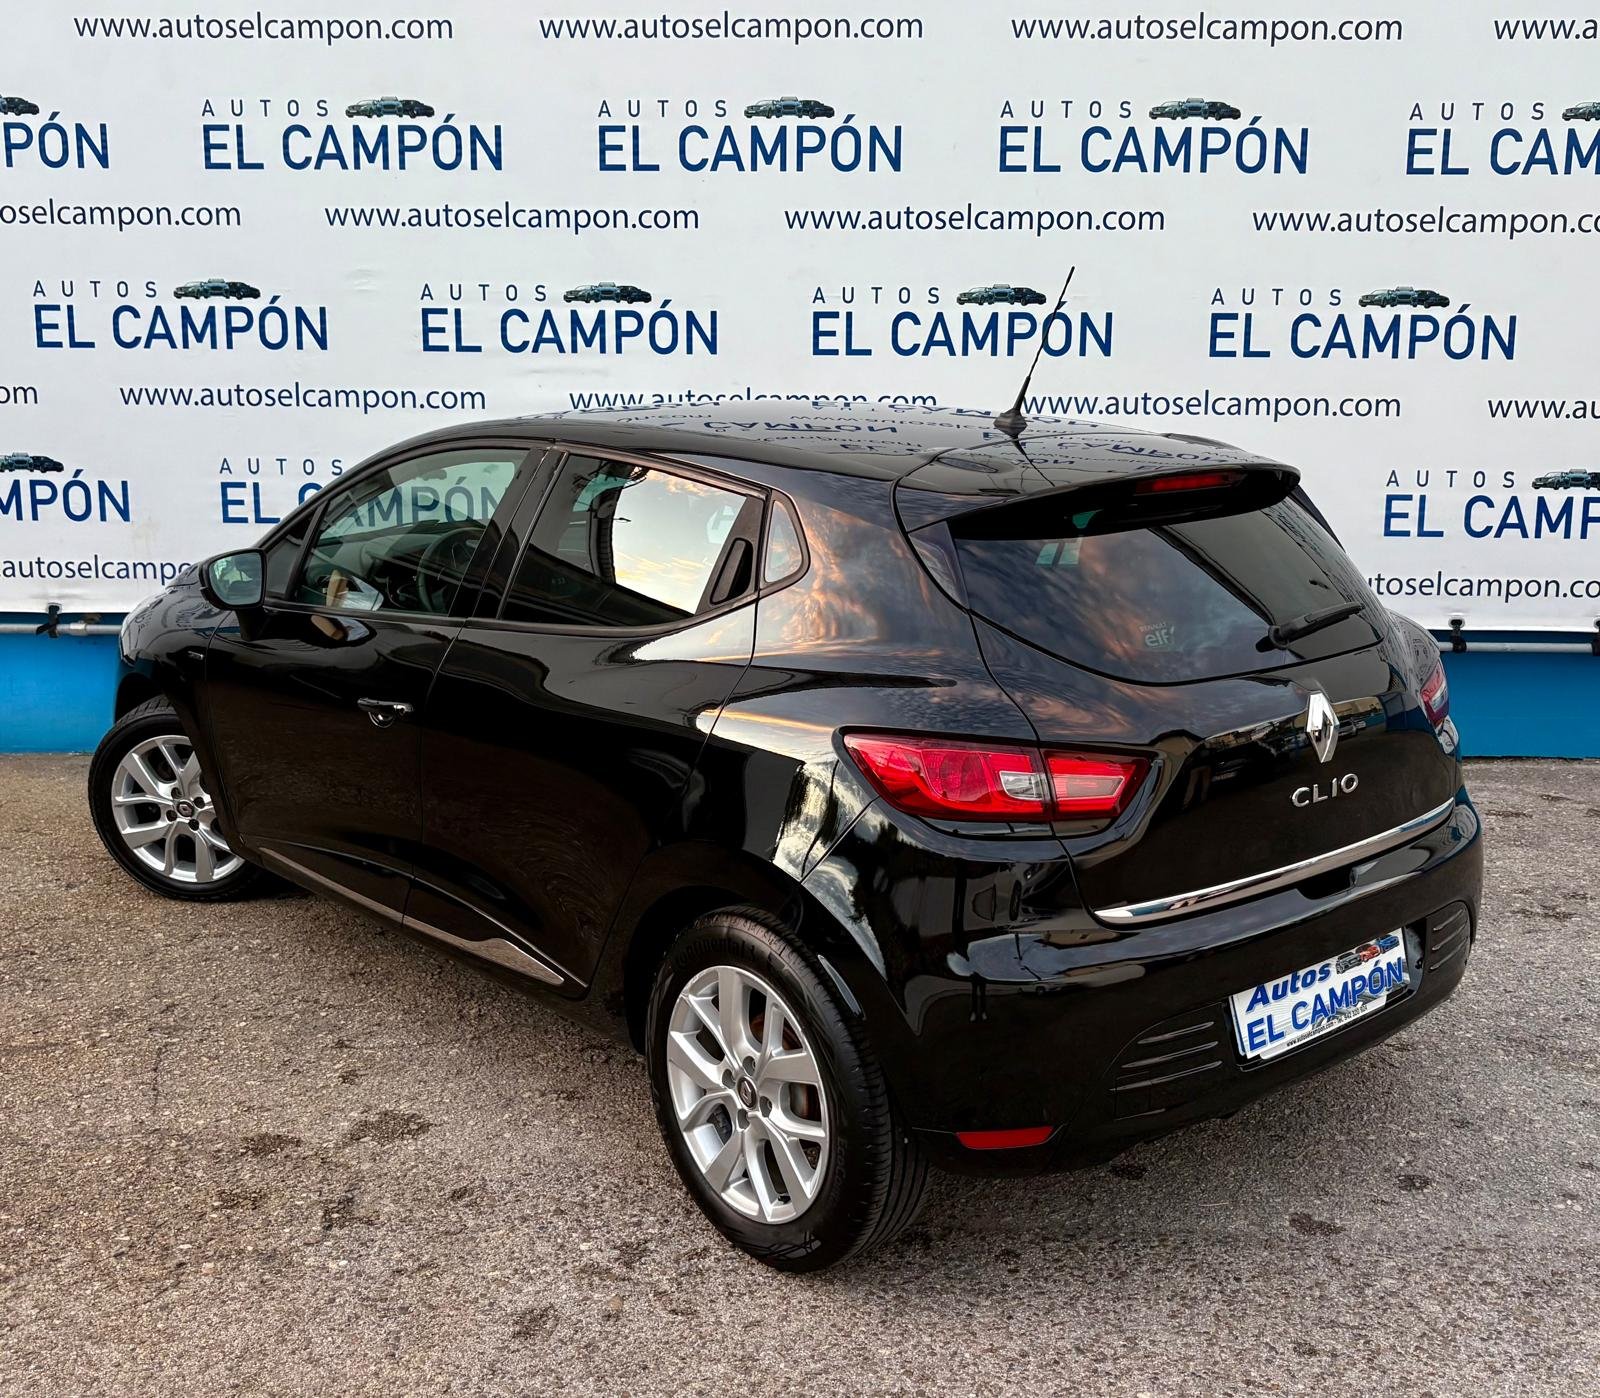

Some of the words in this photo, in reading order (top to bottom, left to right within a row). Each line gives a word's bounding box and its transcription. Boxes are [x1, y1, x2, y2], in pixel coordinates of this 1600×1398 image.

[74, 11, 453, 46] www.autoselcampon.com
[539, 11, 923, 45] www.autoselcampon.com
[1011, 12, 1403, 47] www.autoselcampon.com
[1494, 18, 1598, 40] www.a
[202, 99, 329, 118] AUTOS
[598, 99, 727, 118] AUTOS
[1000, 100, 1132, 119] AUTOS
[1409, 102, 1545, 121] AUTOS
[3, 111, 110, 169] PÓN
[203, 125, 265, 170] EL
[282, 113, 503, 171] CAMPÓN
[598, 125, 660, 172] EL
[678, 114, 902, 173] CAMPÓN
[999, 126, 1061, 173] EL
[1080, 116, 1309, 175] CAMPÓN
[1406, 128, 1470, 175] EL
[1490, 127, 1600, 176] CAM
[324, 200, 699, 235] www.autoselcampon.com
[784, 203, 1165, 237] www.autoselcampon.com
[33, 280, 157, 298] AUTOS
[420, 283, 547, 302] AUTOS
[812, 286, 940, 305] AUTOS
[1211, 287, 1342, 307] AUTOS
[34, 304, 96, 349] EL
[112, 295, 328, 351] CAMPÓN
[421, 307, 483, 353] EL
[500, 299, 718, 355] CAMPÓN
[812, 310, 873, 357] EL
[891, 300, 1113, 358] CAMPÓN
[1209, 312, 1271, 359] EL
[1290, 303, 1517, 361] CAMPÓN
[119, 381, 486, 415] www.autoselcampon.com
[1023, 389, 1401, 422] www.autoselcampon.com
[219, 457, 343, 477] AUTOS
[1386, 469, 1515, 489] AUTOS
[220, 481, 281, 524] EL
[1383, 493, 1445, 538] EL
[1368, 571, 1600, 604] toselcampon.co
[1291, 773, 1359, 808] CLIO
[1246, 962, 1332, 1013] Autos
[1247, 1013, 1285, 1051] EL
[1290, 958, 1404, 1031] CAMPÓN
